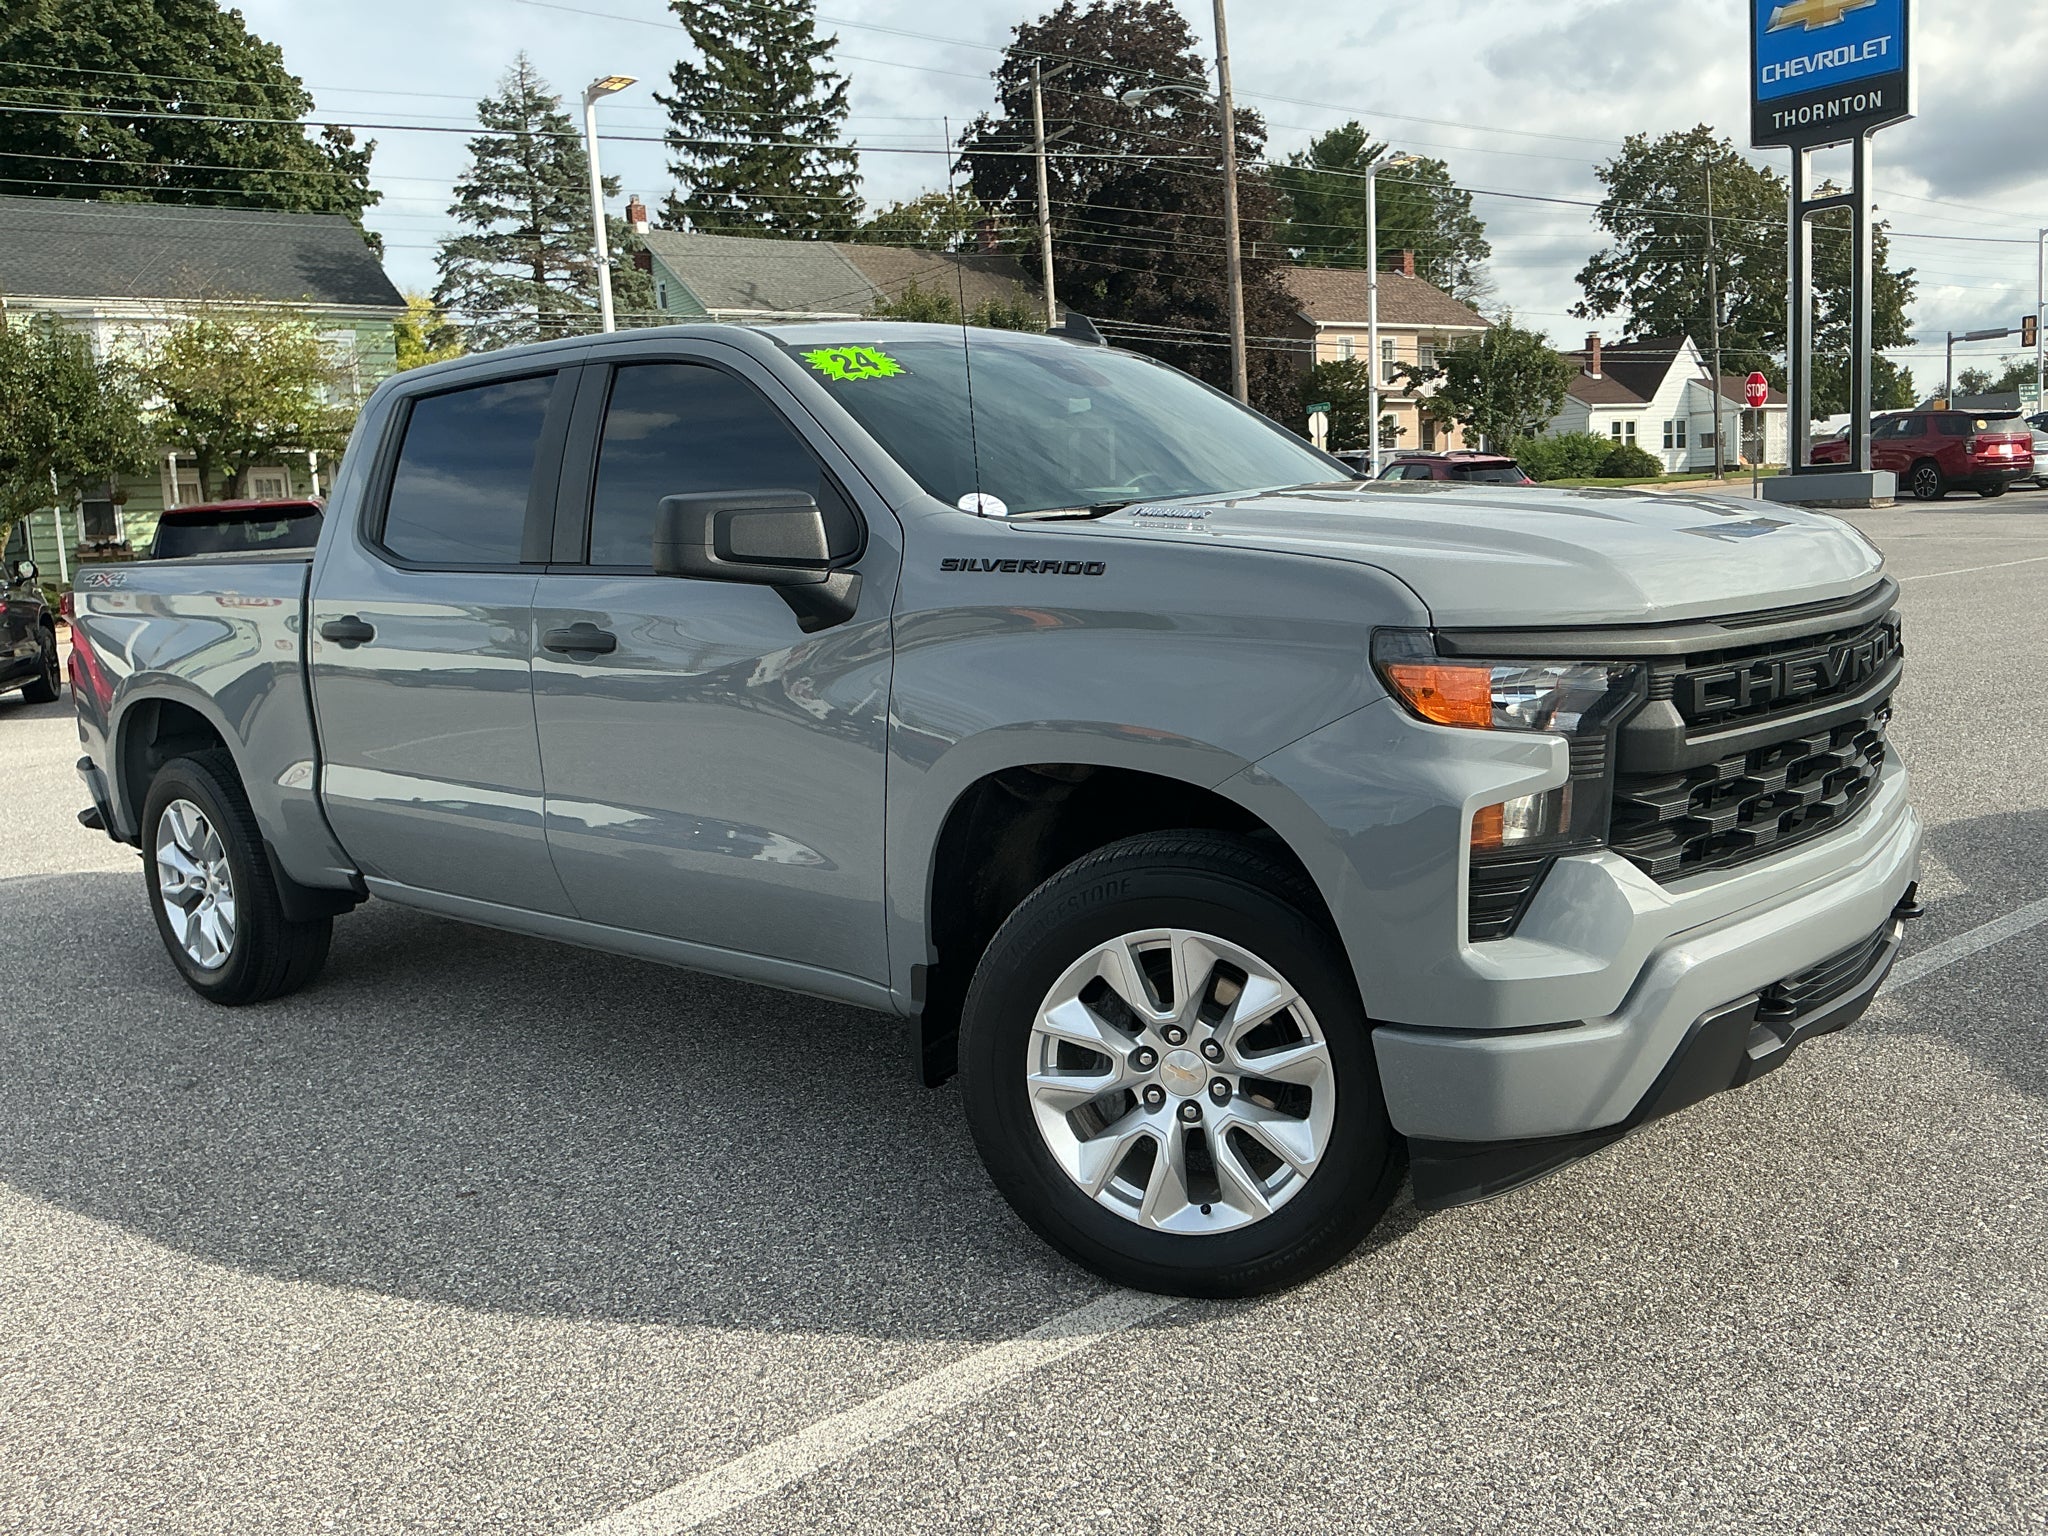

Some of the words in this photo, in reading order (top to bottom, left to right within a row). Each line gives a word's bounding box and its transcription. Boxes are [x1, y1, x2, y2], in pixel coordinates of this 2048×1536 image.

[1762, 35, 1891, 84] CHEVROLET
[1772, 91, 1882, 129] THORNTON
[829, 352, 880, 374] 24
[1746, 383, 1766, 397] STOP
[940, 558, 1106, 576] SILVERADO
[1693, 618, 1901, 714] CHEVROLE
